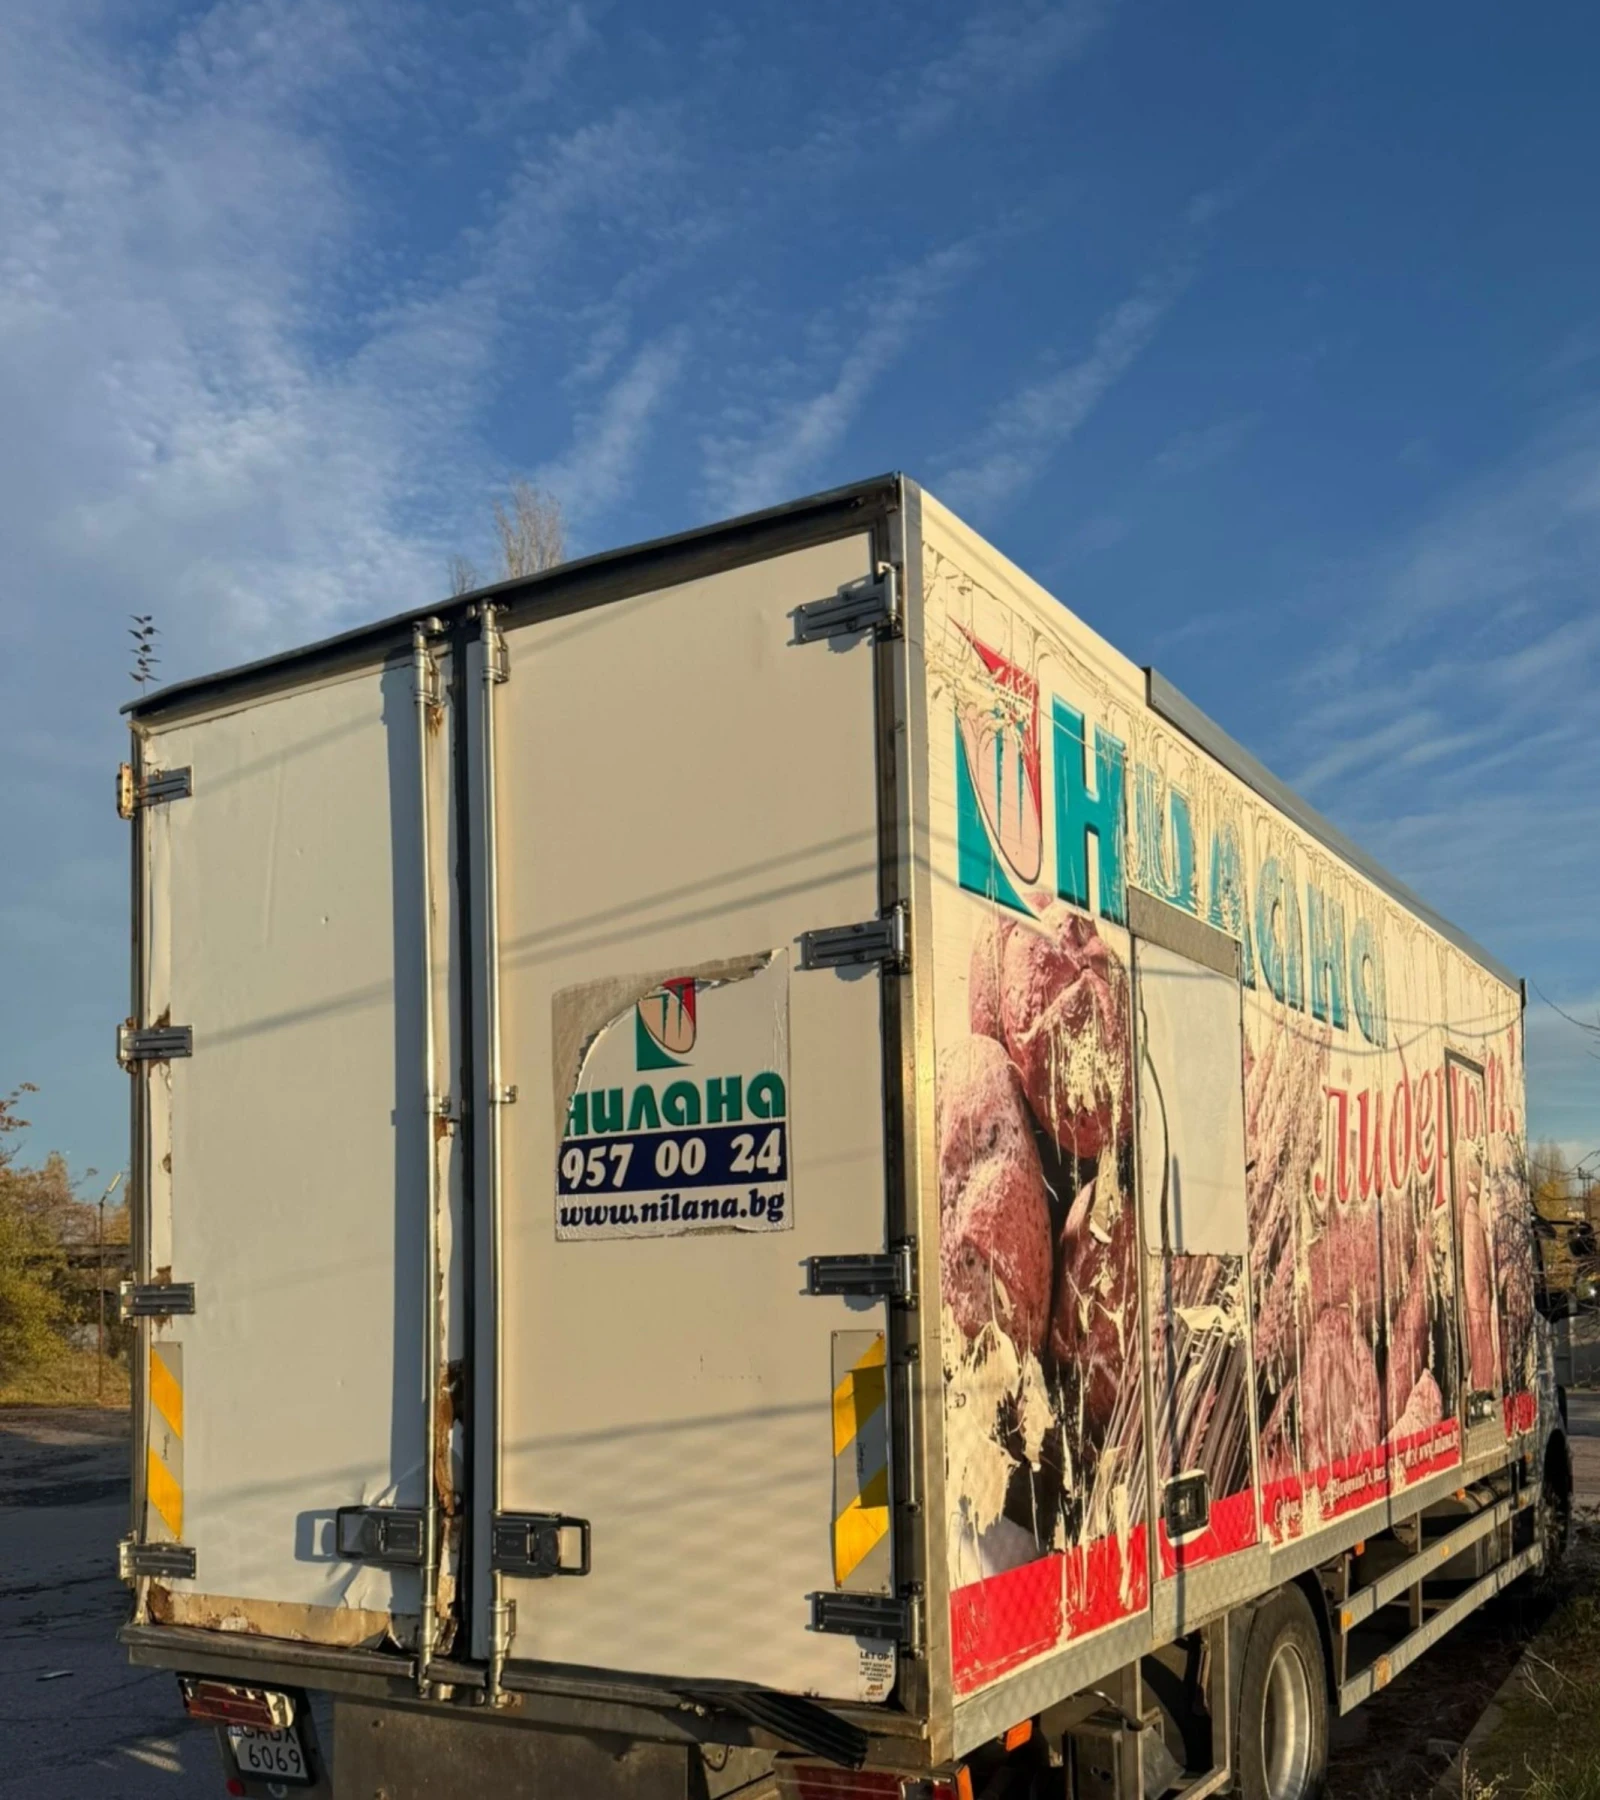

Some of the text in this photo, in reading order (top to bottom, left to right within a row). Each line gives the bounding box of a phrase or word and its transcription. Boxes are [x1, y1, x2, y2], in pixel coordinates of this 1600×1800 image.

[561, 1128, 782, 1190] 957 00 24
[560, 1188, 784, 1227] www.nilana.bg
[248, 1743, 301, 1774] 6069
